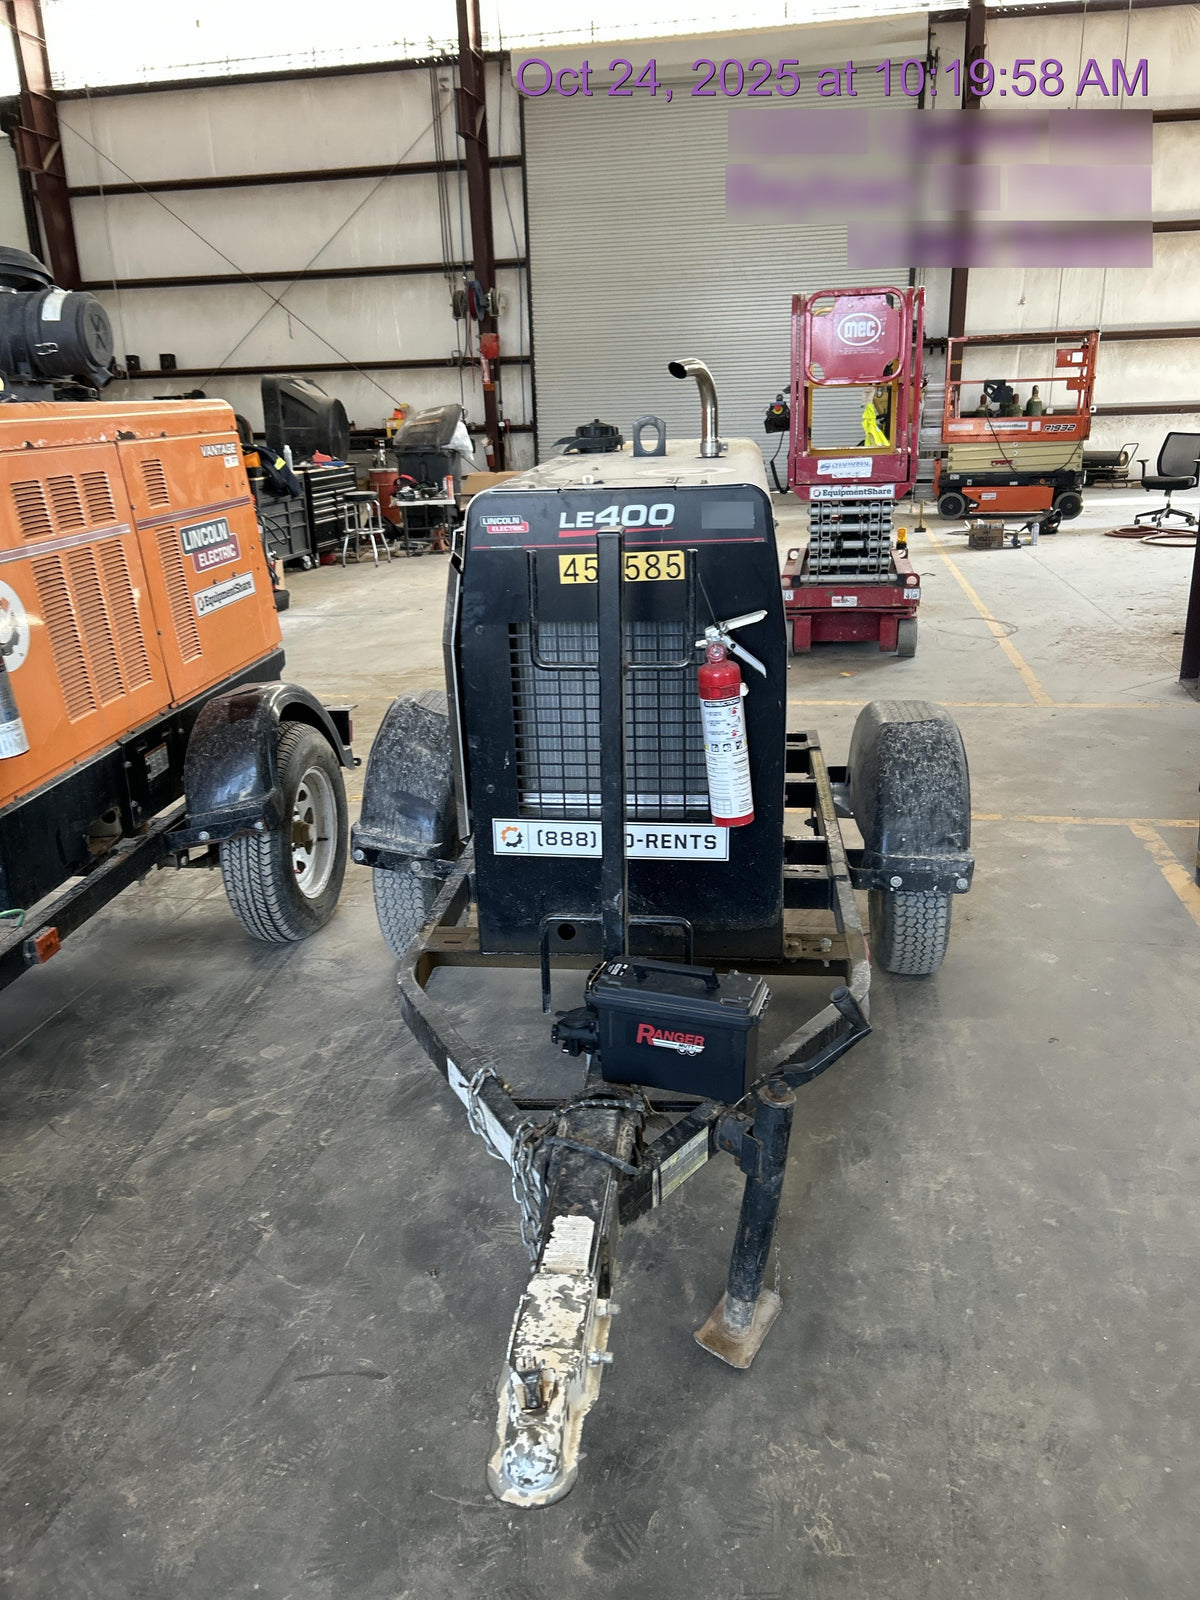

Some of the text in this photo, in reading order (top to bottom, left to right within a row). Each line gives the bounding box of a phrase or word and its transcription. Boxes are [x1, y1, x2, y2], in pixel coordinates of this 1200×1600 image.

[1043, 423, 1076, 433] R1932
[200, 442, 237, 458] VANTAGE
[822, 488, 892, 498] EquipmentShare
[482, 516, 520, 525] LINCOLN
[558, 503, 676, 529] LE400
[182, 522, 228, 550] LINCOLN
[198, 544, 237, 568] ELECTRIC
[204, 580, 252, 607] EquipmentShare
[537, 829, 597, 849] (888)
[636, 1023, 705, 1046] RANGER
